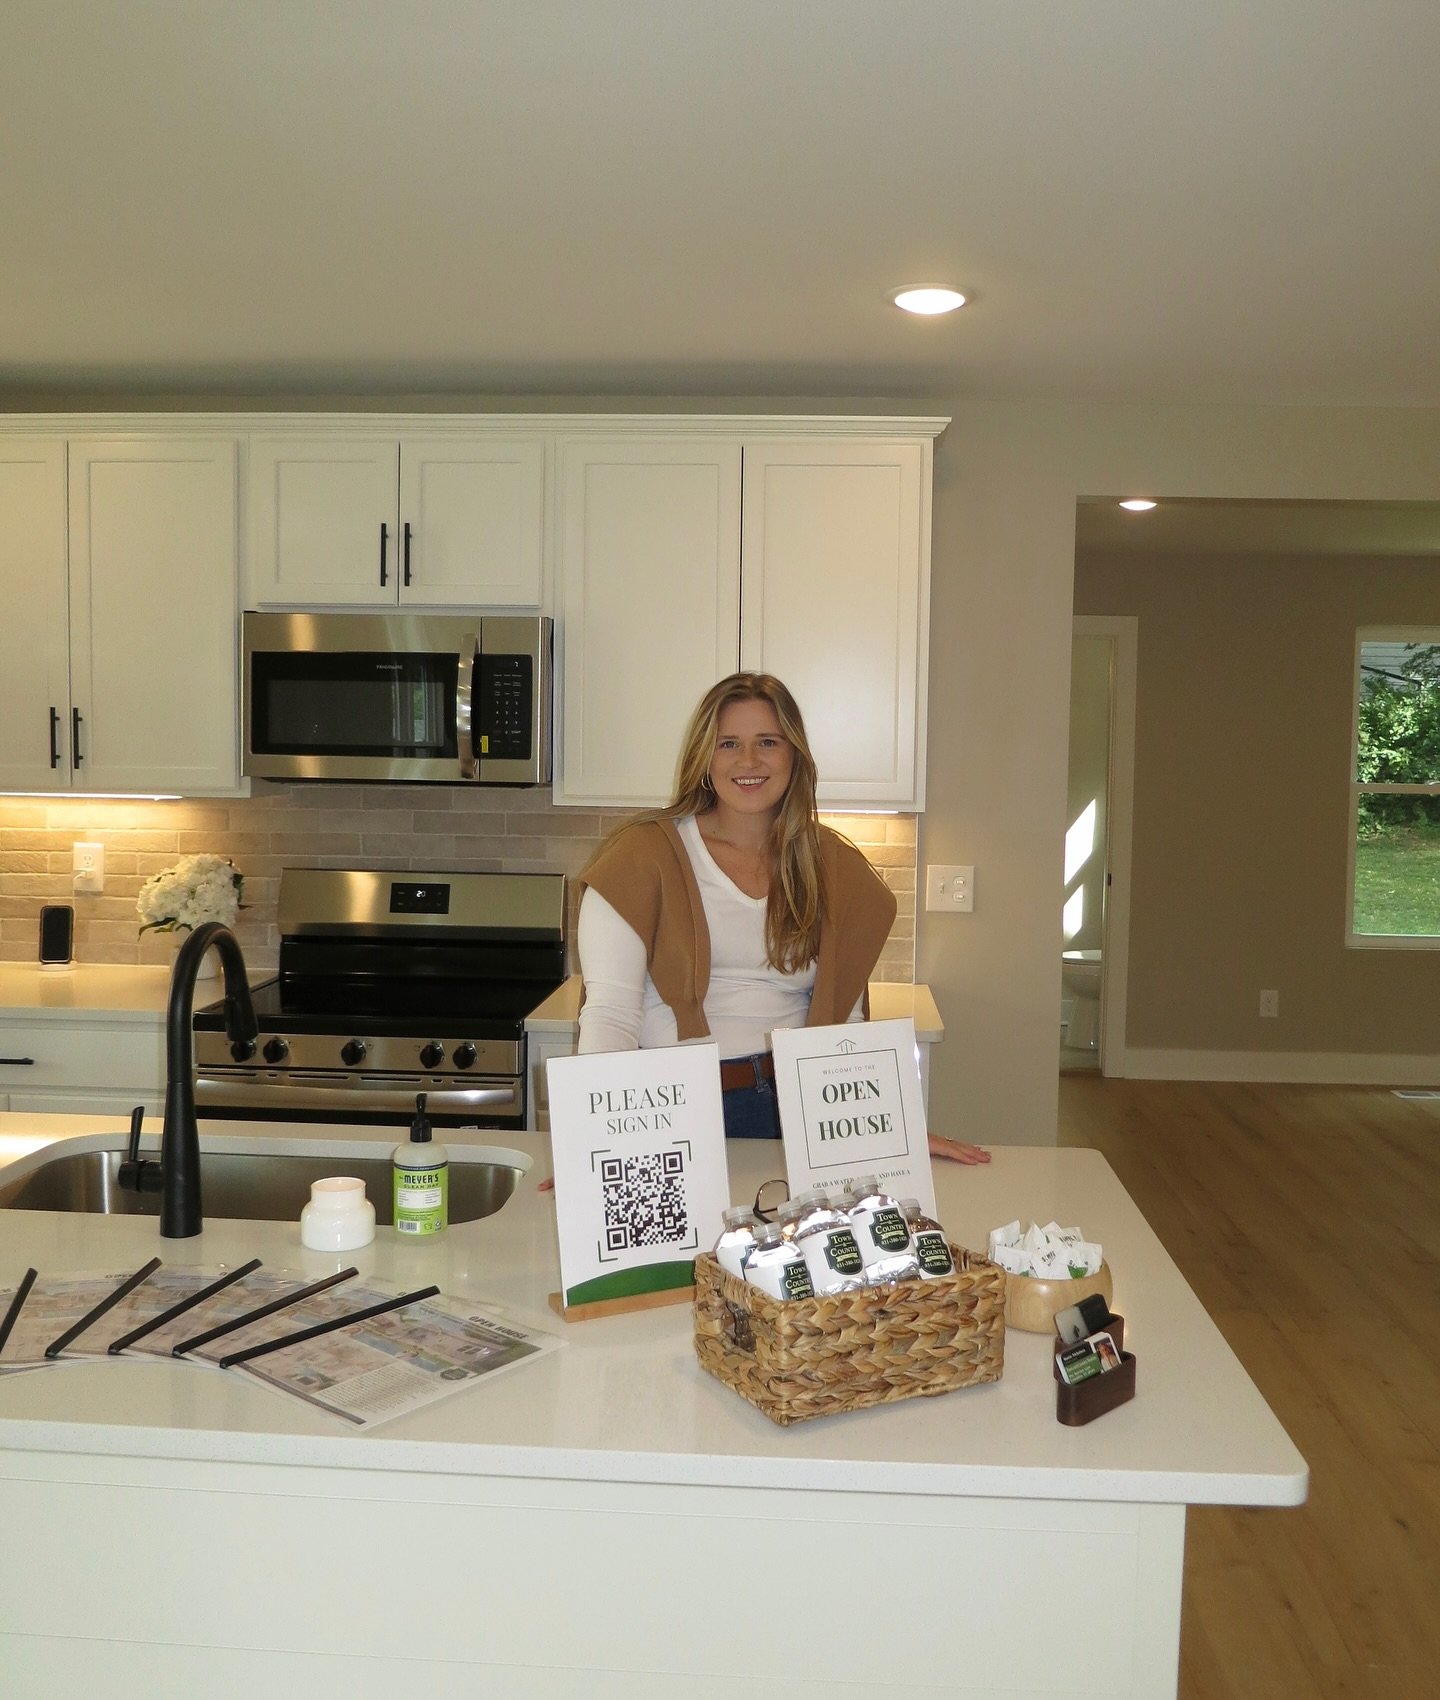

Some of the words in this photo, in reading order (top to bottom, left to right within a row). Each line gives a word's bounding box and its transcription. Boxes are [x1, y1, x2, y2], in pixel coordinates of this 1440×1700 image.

[822, 1066, 852, 1075] WELCOME
[822, 1079, 880, 1104] OPEN
[588, 1083, 686, 1114] PLEASE
[606, 1115, 649, 1135] SIGN
[654, 1112, 672, 1130] IN
[818, 1113, 893, 1141] HOUSE
[404, 1173, 439, 1184] MEYER'S
[890, 1169, 904, 1178] HAVE
[812, 1181, 829, 1189] GRAB
[876, 1213, 898, 1221] TOWN
[831, 1235, 852, 1244] TOWN
[921, 1237, 941, 1245] TOWN
[468, 1316, 496, 1327] OPEN
[494, 1326, 529, 1339] HOUSE
